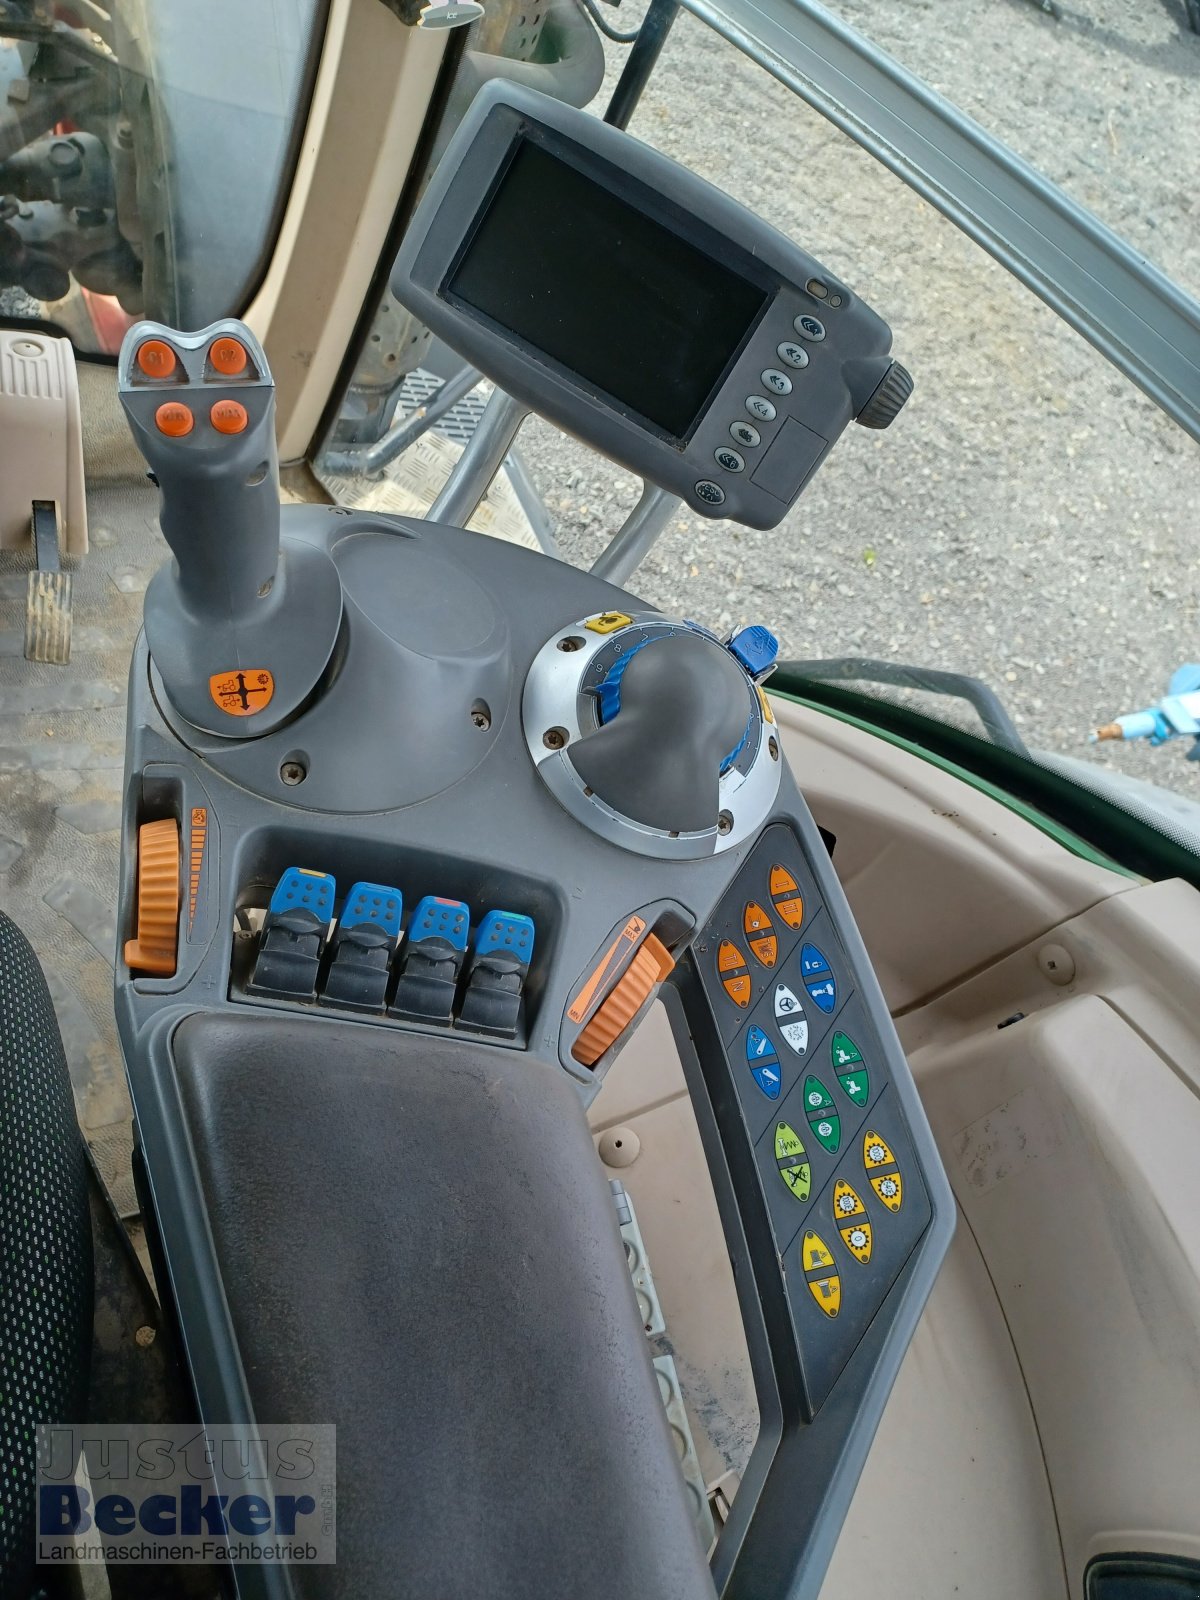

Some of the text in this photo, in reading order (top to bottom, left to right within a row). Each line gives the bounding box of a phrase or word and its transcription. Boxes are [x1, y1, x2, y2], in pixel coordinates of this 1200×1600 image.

[793, 354, 802, 364] 2
[777, 381, 786, 390] 3
[761, 408, 769, 417] 4
[641, 633, 649, 642] 7
[614, 643, 622, 653] 8
[595, 663, 604, 673] 9
[624, 929, 637, 940] MAX
[570, 1009, 581, 1020] MIN
